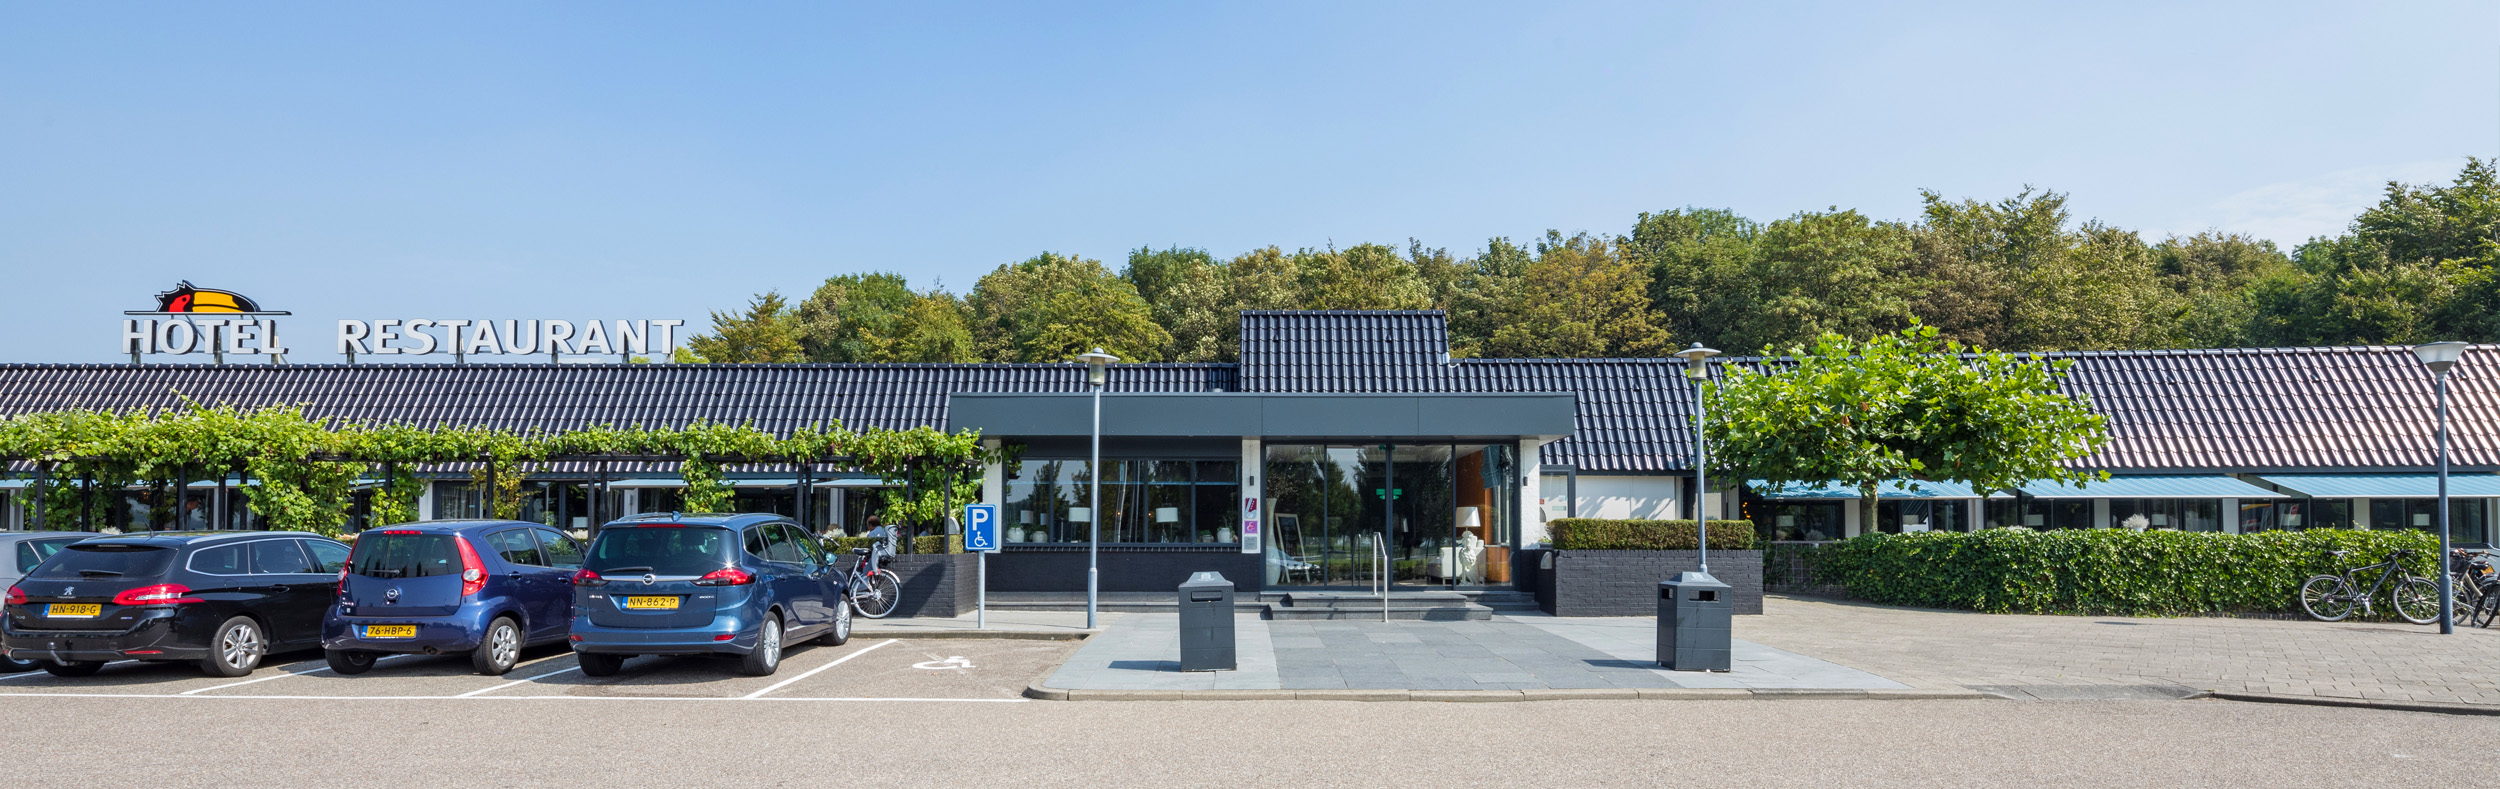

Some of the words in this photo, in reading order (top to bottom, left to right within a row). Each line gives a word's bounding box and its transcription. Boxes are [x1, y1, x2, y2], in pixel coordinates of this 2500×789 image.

[122, 319, 289, 355] HOTEL
[337, 318, 685, 356] RESTAURANT
[972, 508, 989, 531] P
[51, 604, 97, 614] HN-918-G
[629, 597, 676, 607] NN-862-P
[369, 626, 412, 636] 76-HBP-6
